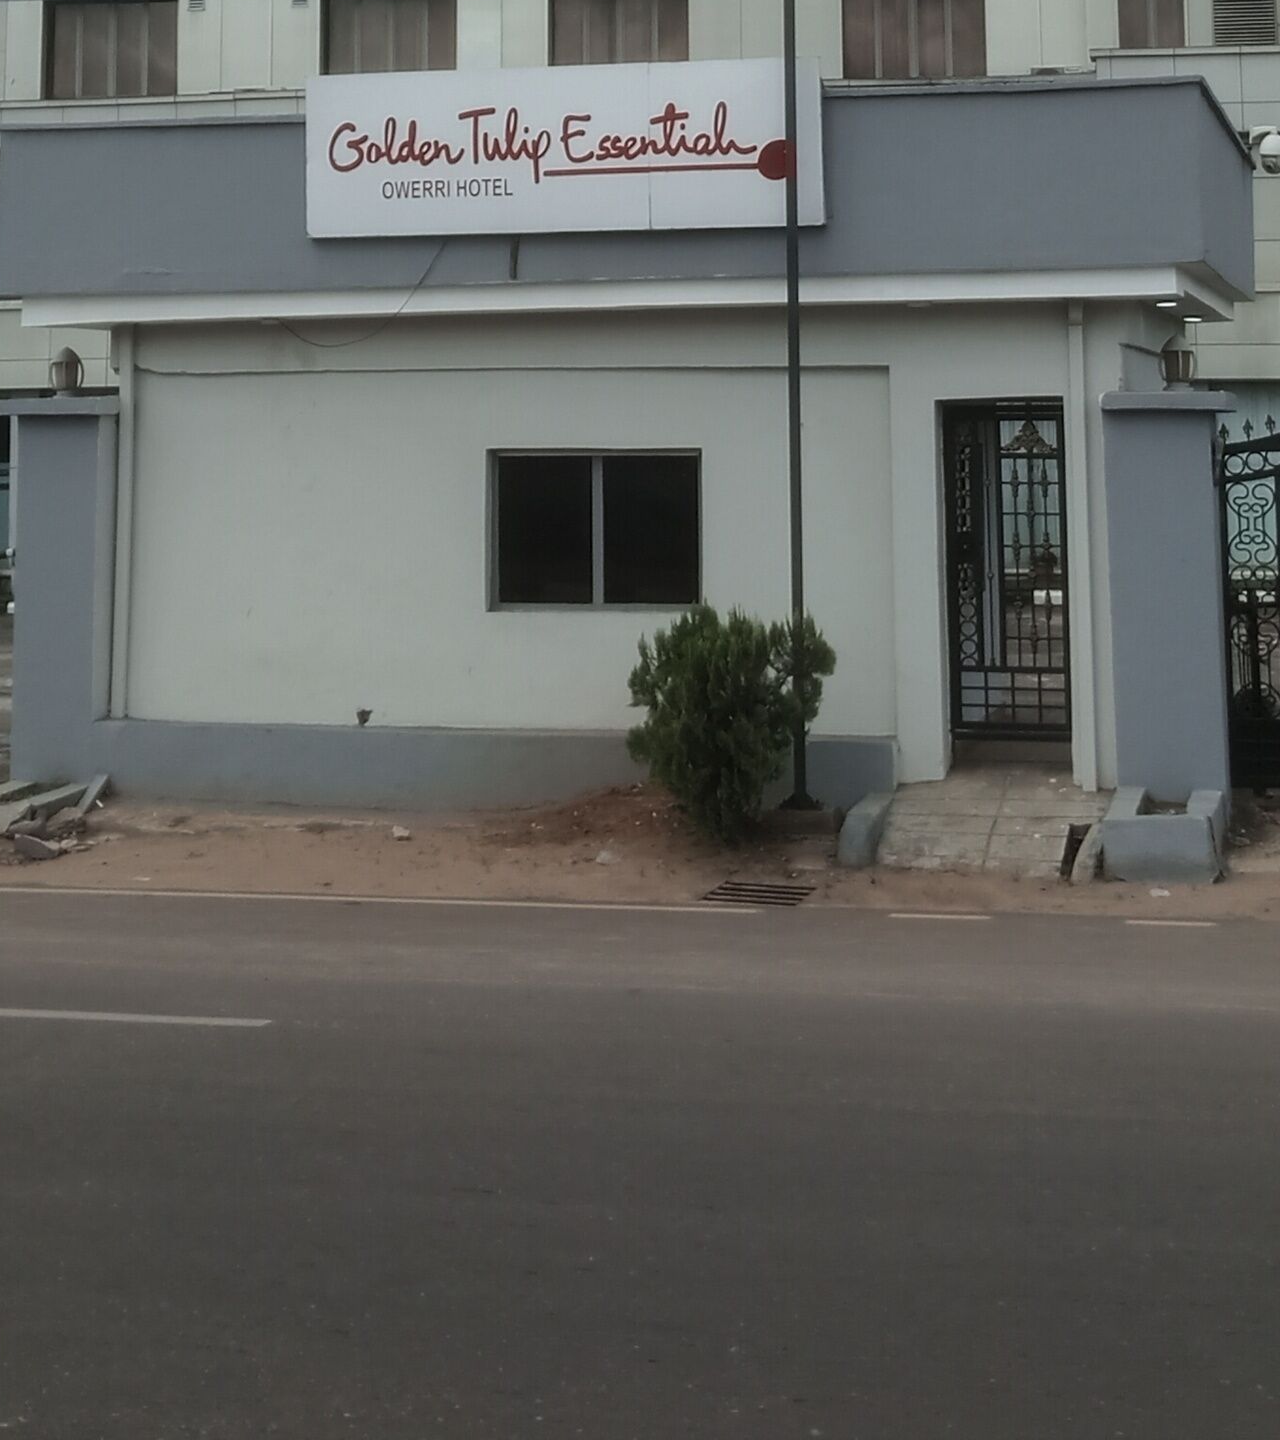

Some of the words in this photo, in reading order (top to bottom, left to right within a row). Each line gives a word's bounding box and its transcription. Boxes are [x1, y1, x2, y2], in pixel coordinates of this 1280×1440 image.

[328, 117, 465, 172] Golden
[458, 107, 551, 184] Tulip
[382, 180, 451, 199] OWERRI
[456, 178, 514, 197] HOTEL
